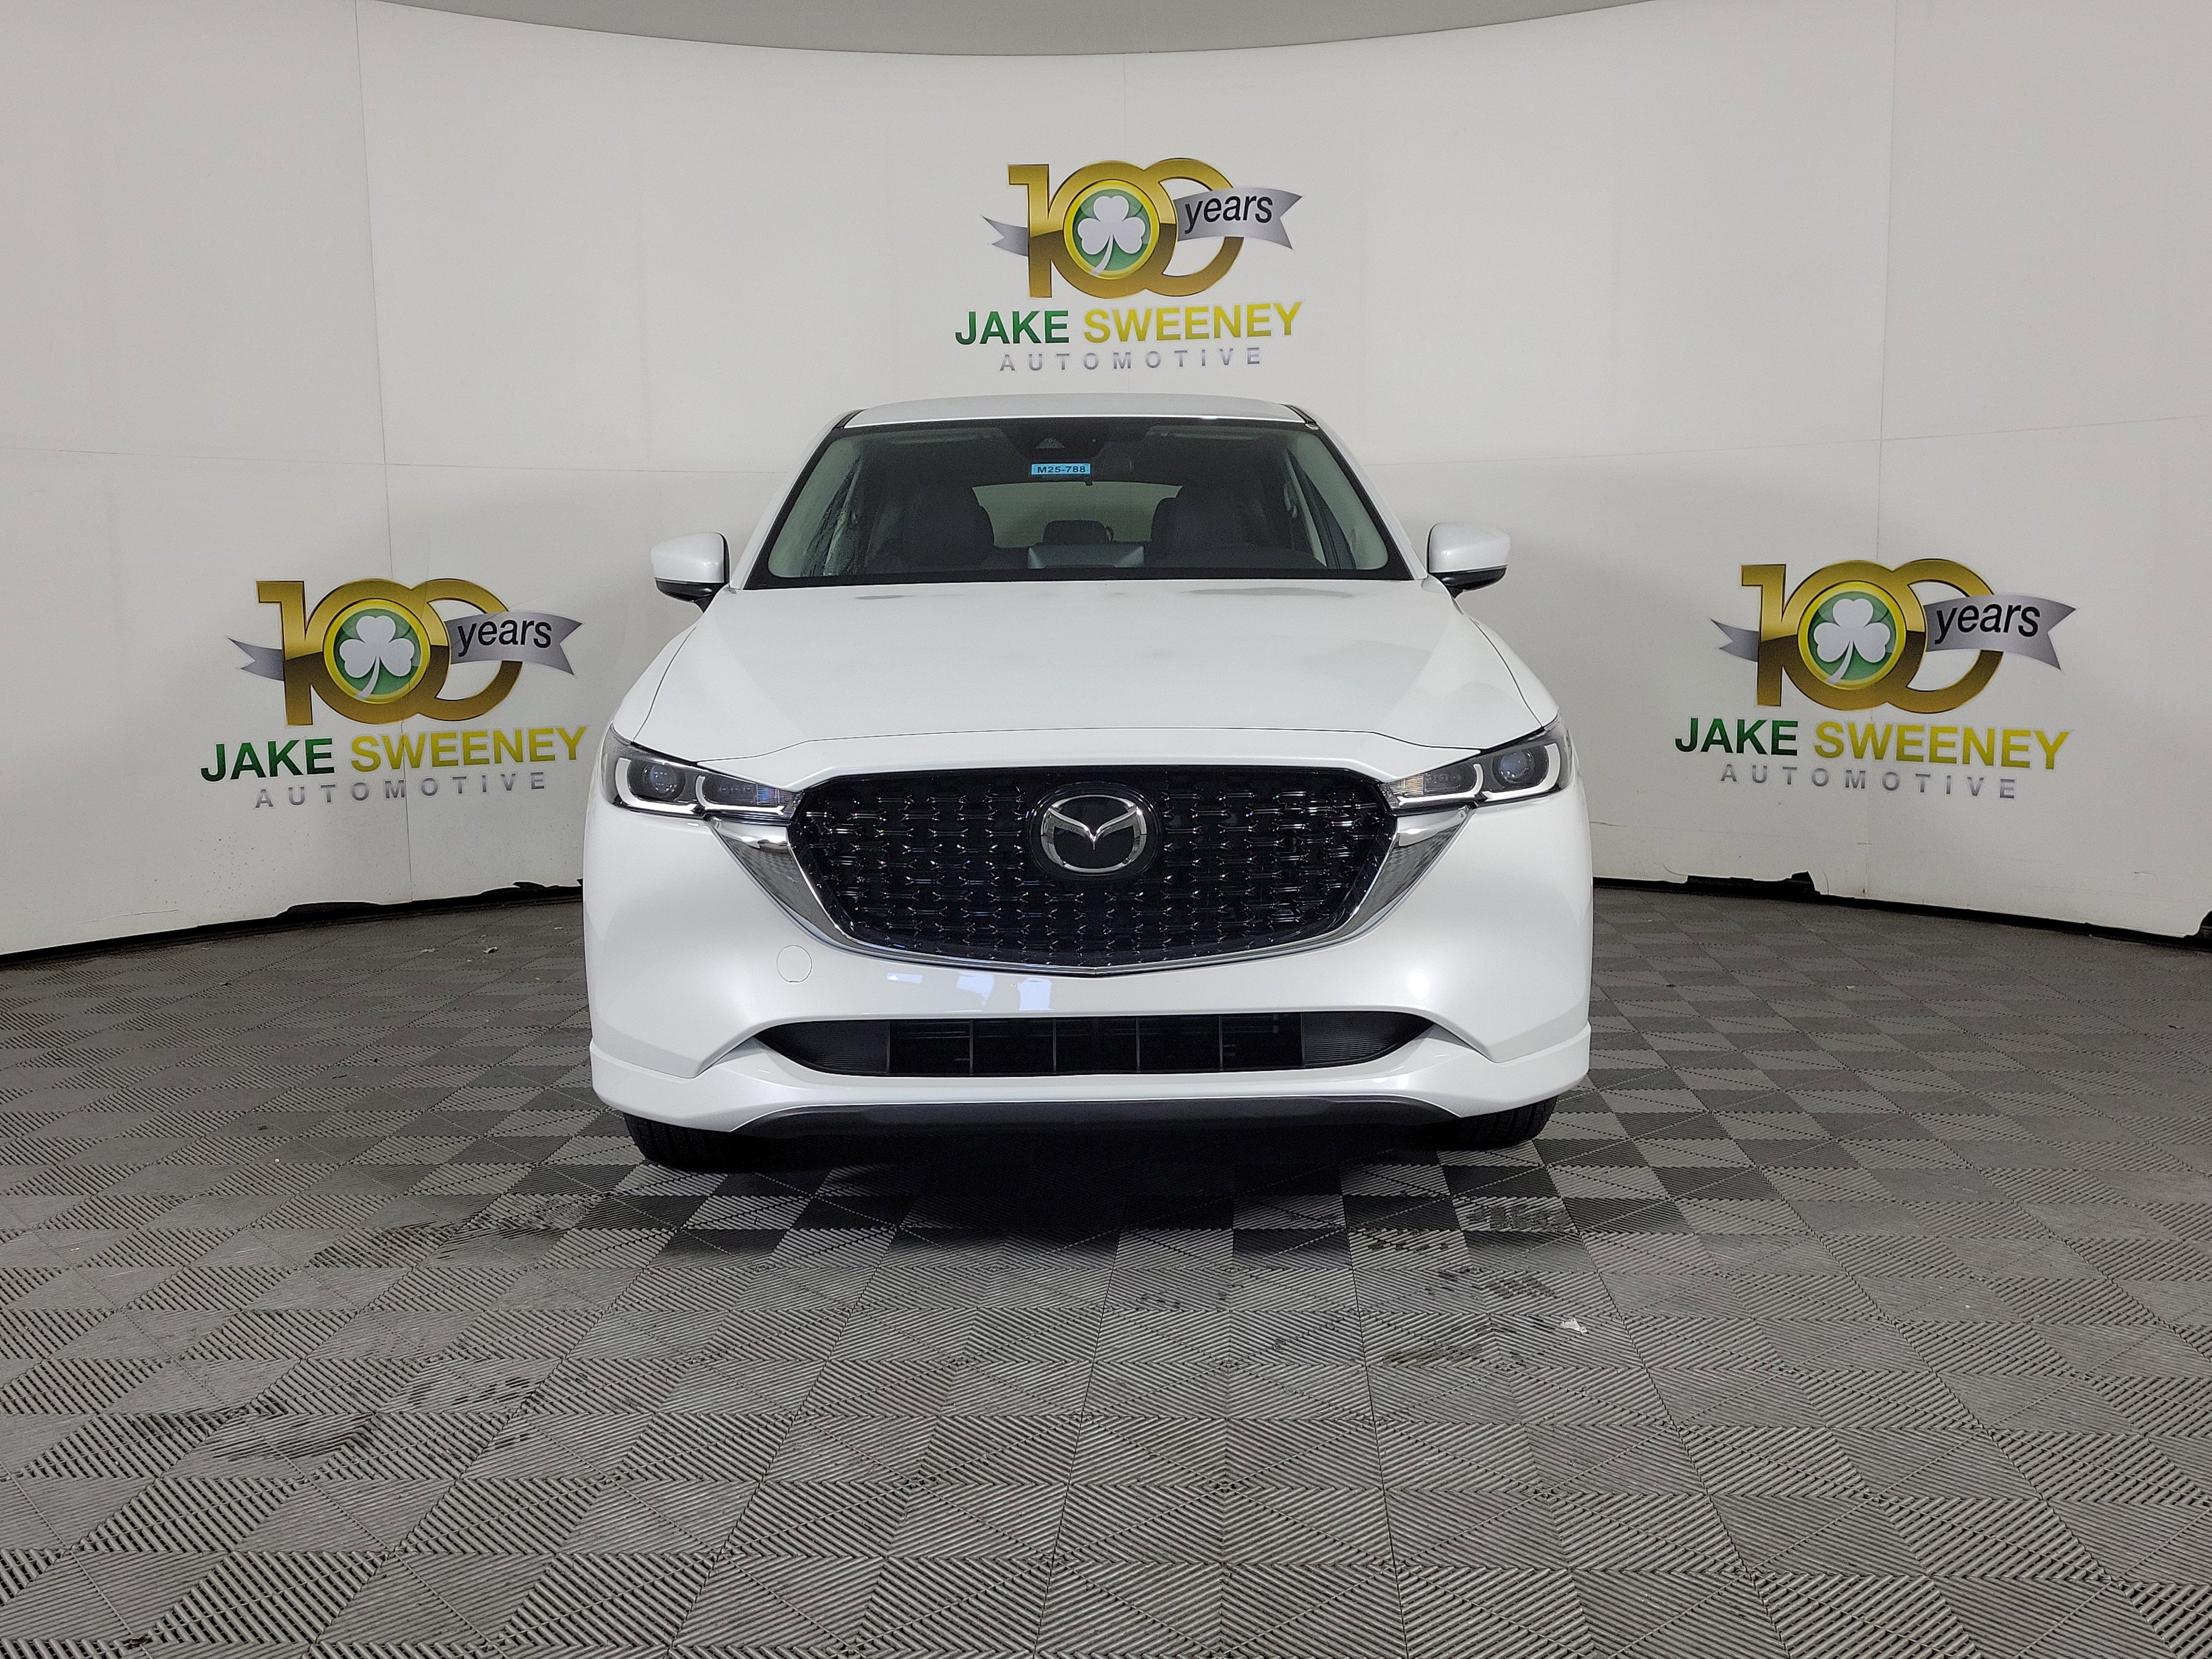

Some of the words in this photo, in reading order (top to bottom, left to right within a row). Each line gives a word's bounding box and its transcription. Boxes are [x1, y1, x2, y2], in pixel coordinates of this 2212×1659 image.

[1007, 157, 1244, 297] 100
[1184, 195, 1273, 233] years
[955, 310, 1069, 345] JAKE
[1084, 301, 1302, 343] SWEENEY
[1000, 347, 1260, 371] AUTOMOTIVE
[256, 578, 522, 726] 100
[458, 618, 551, 657] years
[1741, 558, 2004, 714] 100
[1933, 603, 2040, 645] years
[201, 738, 335, 782] JAKE
[351, 726, 586, 772] SWEENEY
[1675, 717, 1798, 756] JAKE
[1814, 721, 2070, 770] SWEENEY
[255, 771, 545, 809] AUTOMOTIVE
[1720, 764, 2015, 799] AUTOMOTIVE
